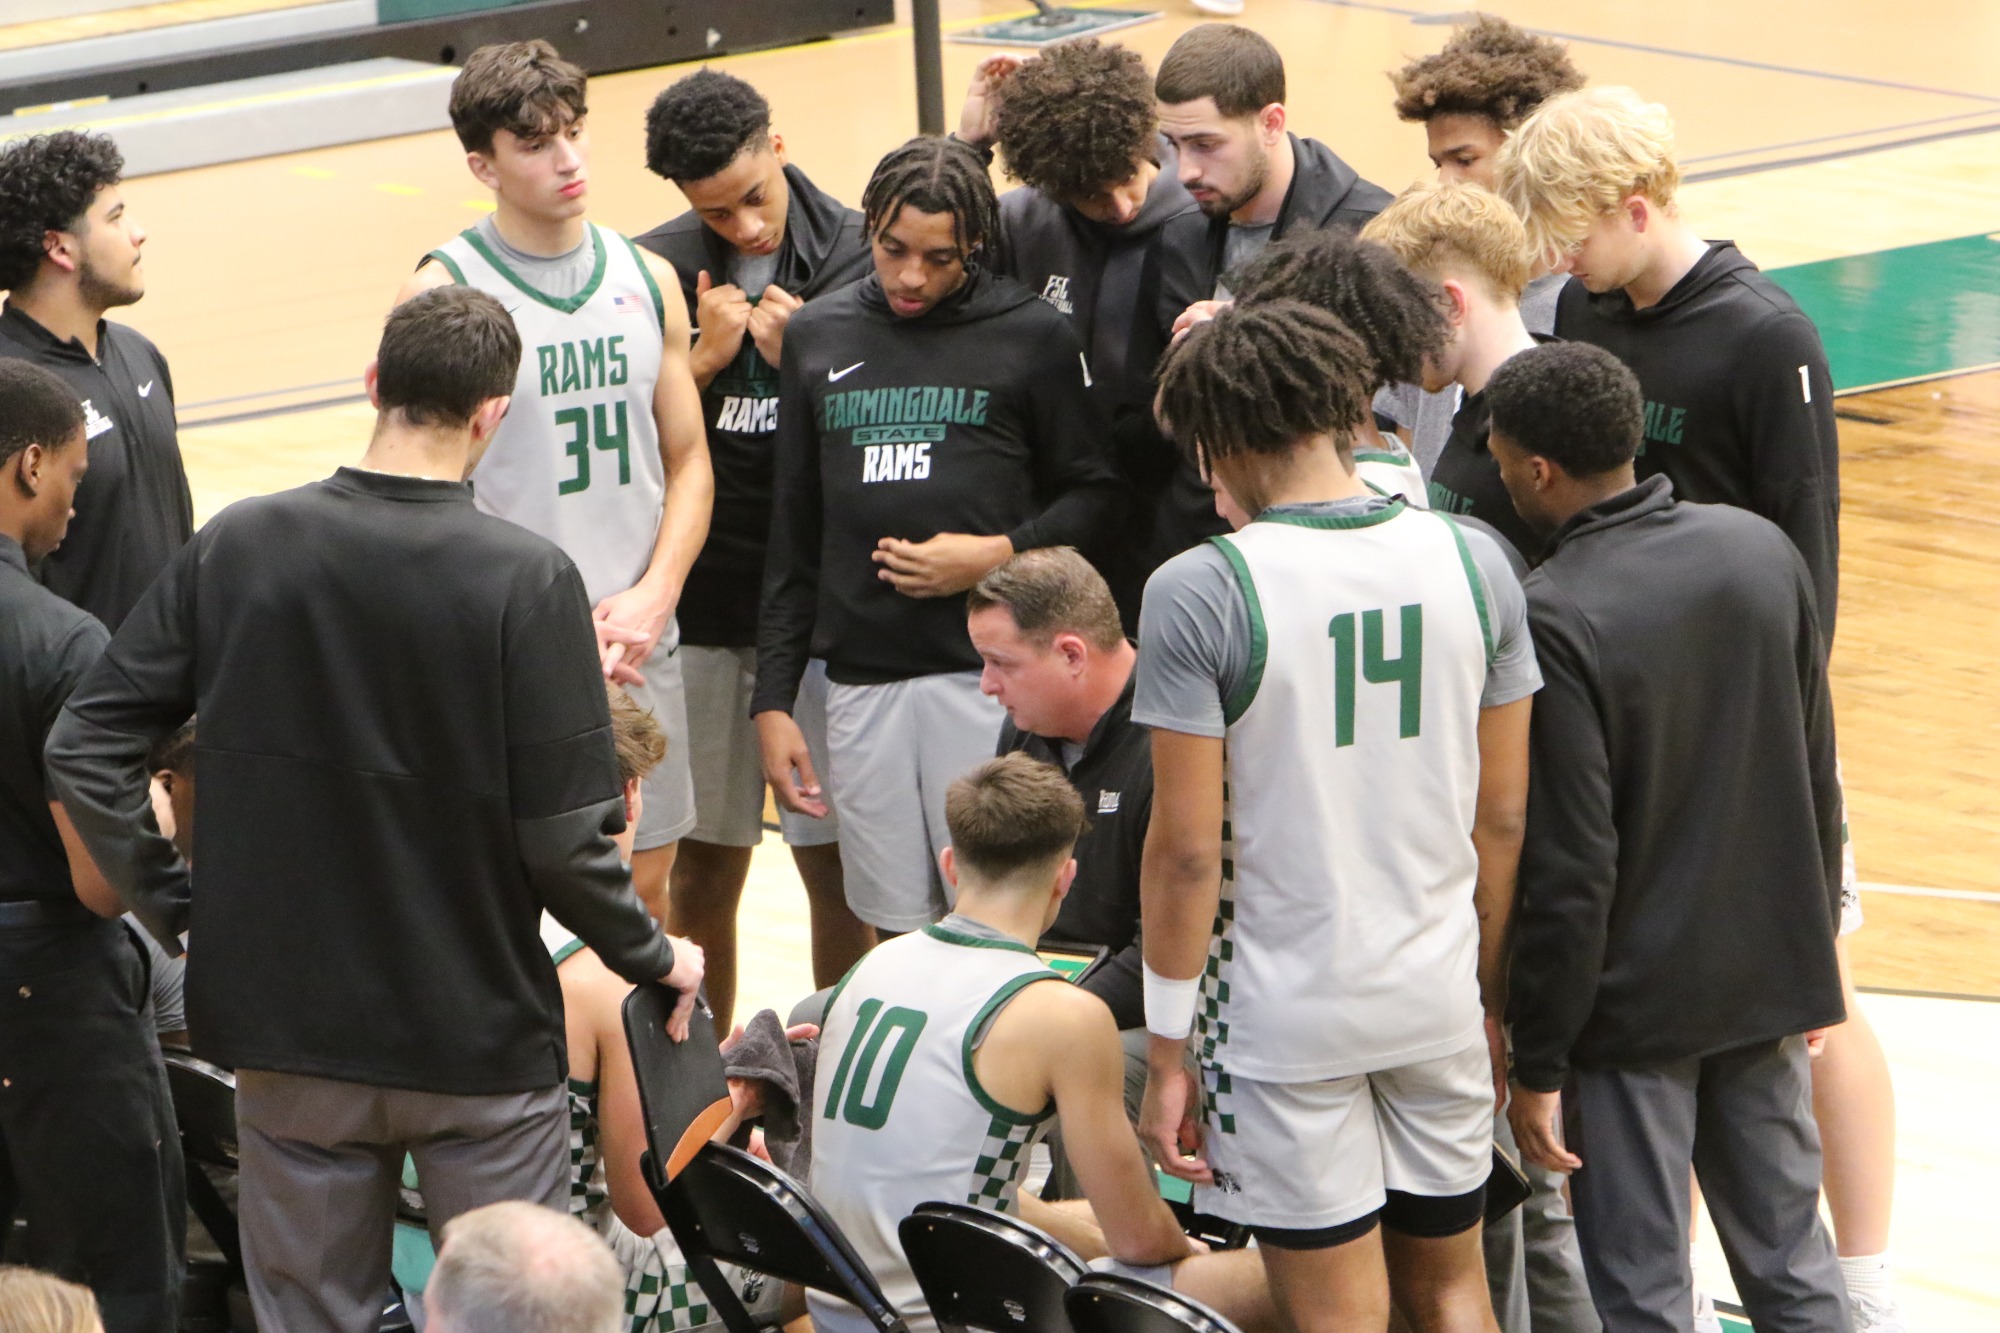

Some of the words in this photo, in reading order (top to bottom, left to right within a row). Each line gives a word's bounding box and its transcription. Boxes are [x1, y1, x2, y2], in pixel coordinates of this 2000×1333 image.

[1042, 274, 1070, 300] FSC
[536, 335, 628, 397] RAMS
[1798, 364, 1811, 404] 1
[716, 396, 779, 433] RAMS
[824, 386, 990, 432] FARMINGDALE
[555, 401, 631, 496] 34
[857, 427, 940, 442] STATE
[863, 442, 931, 484] RAMS
[1328, 603, 1422, 749] 14
[823, 997, 928, 1131] 10
